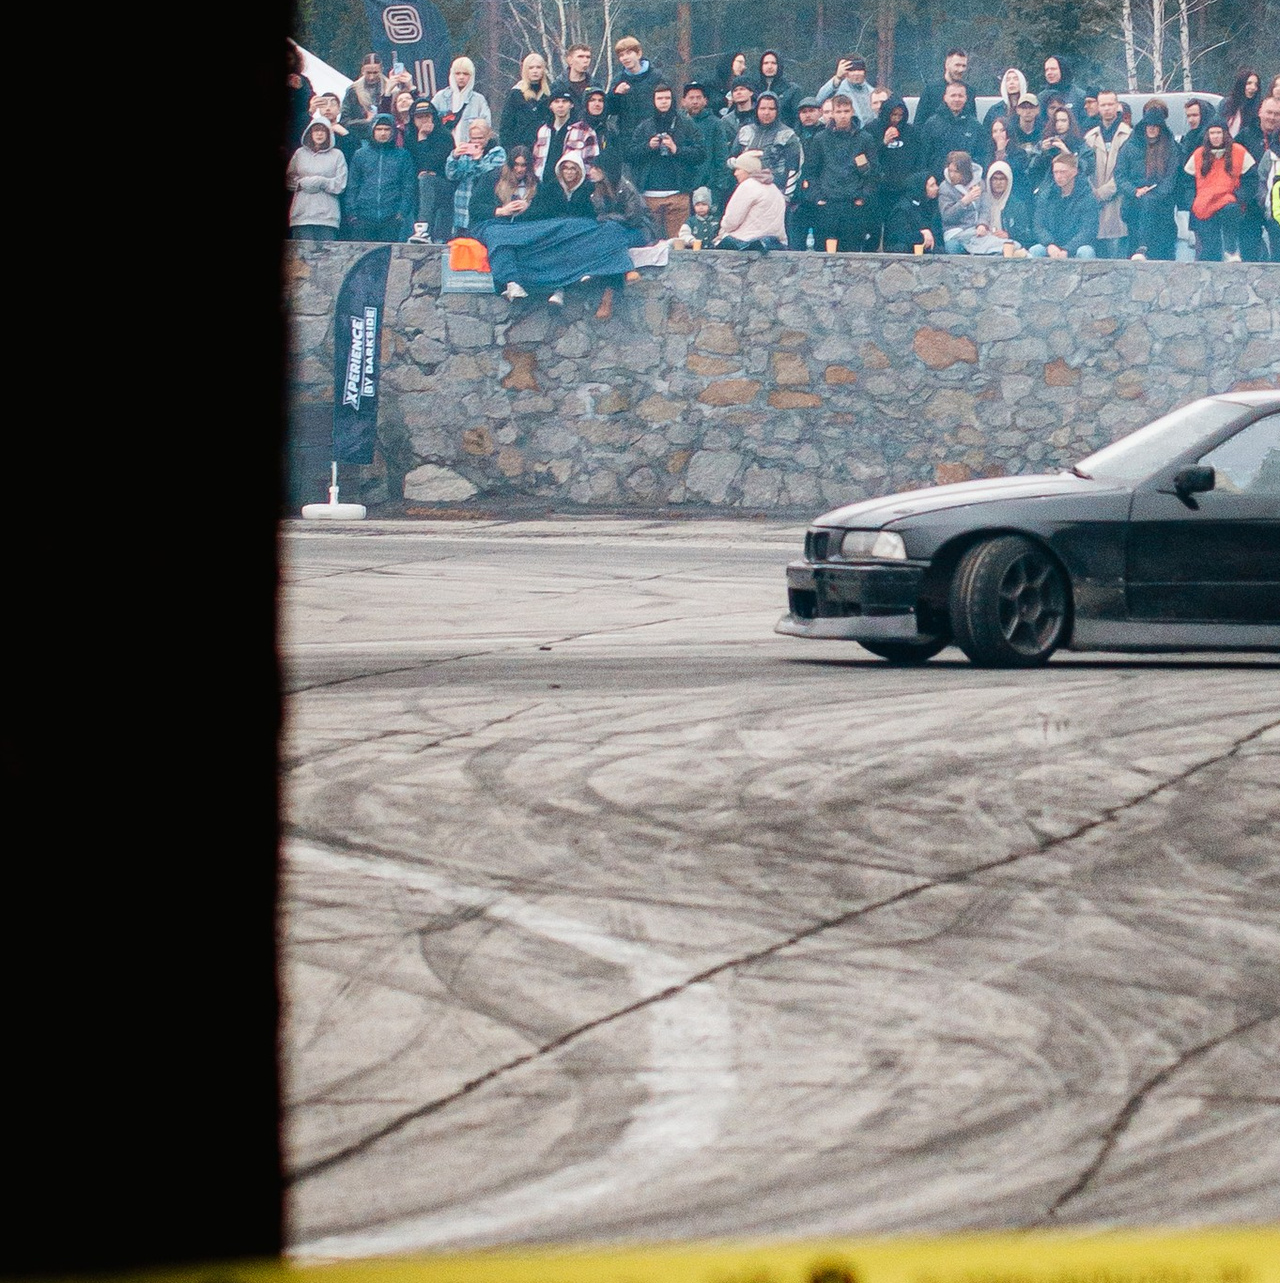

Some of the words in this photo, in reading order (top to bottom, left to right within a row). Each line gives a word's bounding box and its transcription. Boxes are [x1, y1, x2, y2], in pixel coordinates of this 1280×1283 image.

[346, 319, 364, 404] XPERIENCE
[365, 310, 375, 374] DARKSIDE
[364, 378, 374, 394] BY
